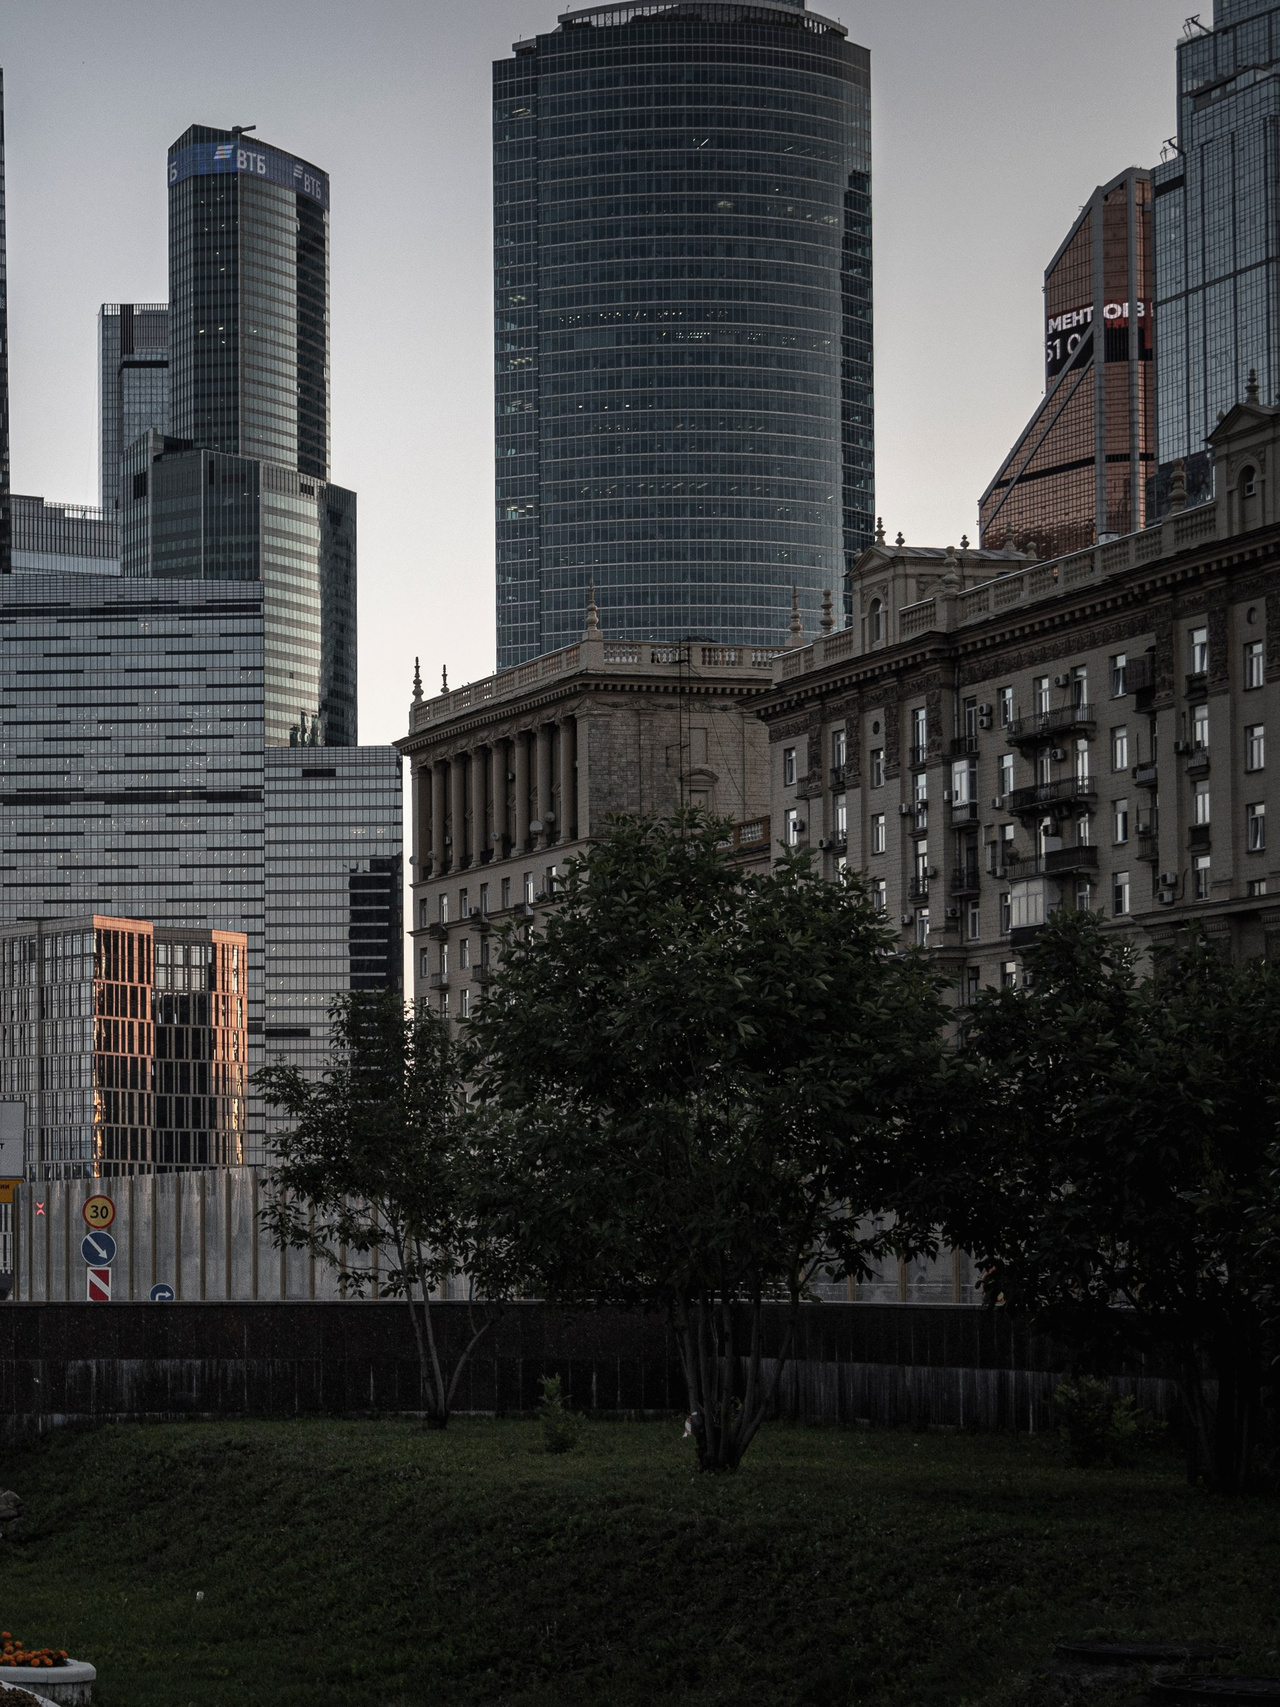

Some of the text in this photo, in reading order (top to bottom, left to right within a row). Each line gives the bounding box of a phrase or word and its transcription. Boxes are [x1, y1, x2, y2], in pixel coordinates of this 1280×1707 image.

[237, 150, 266, 175] ВТБ
[304, 174, 322, 200] ВТБ
[90, 1205, 109, 1219] 30
